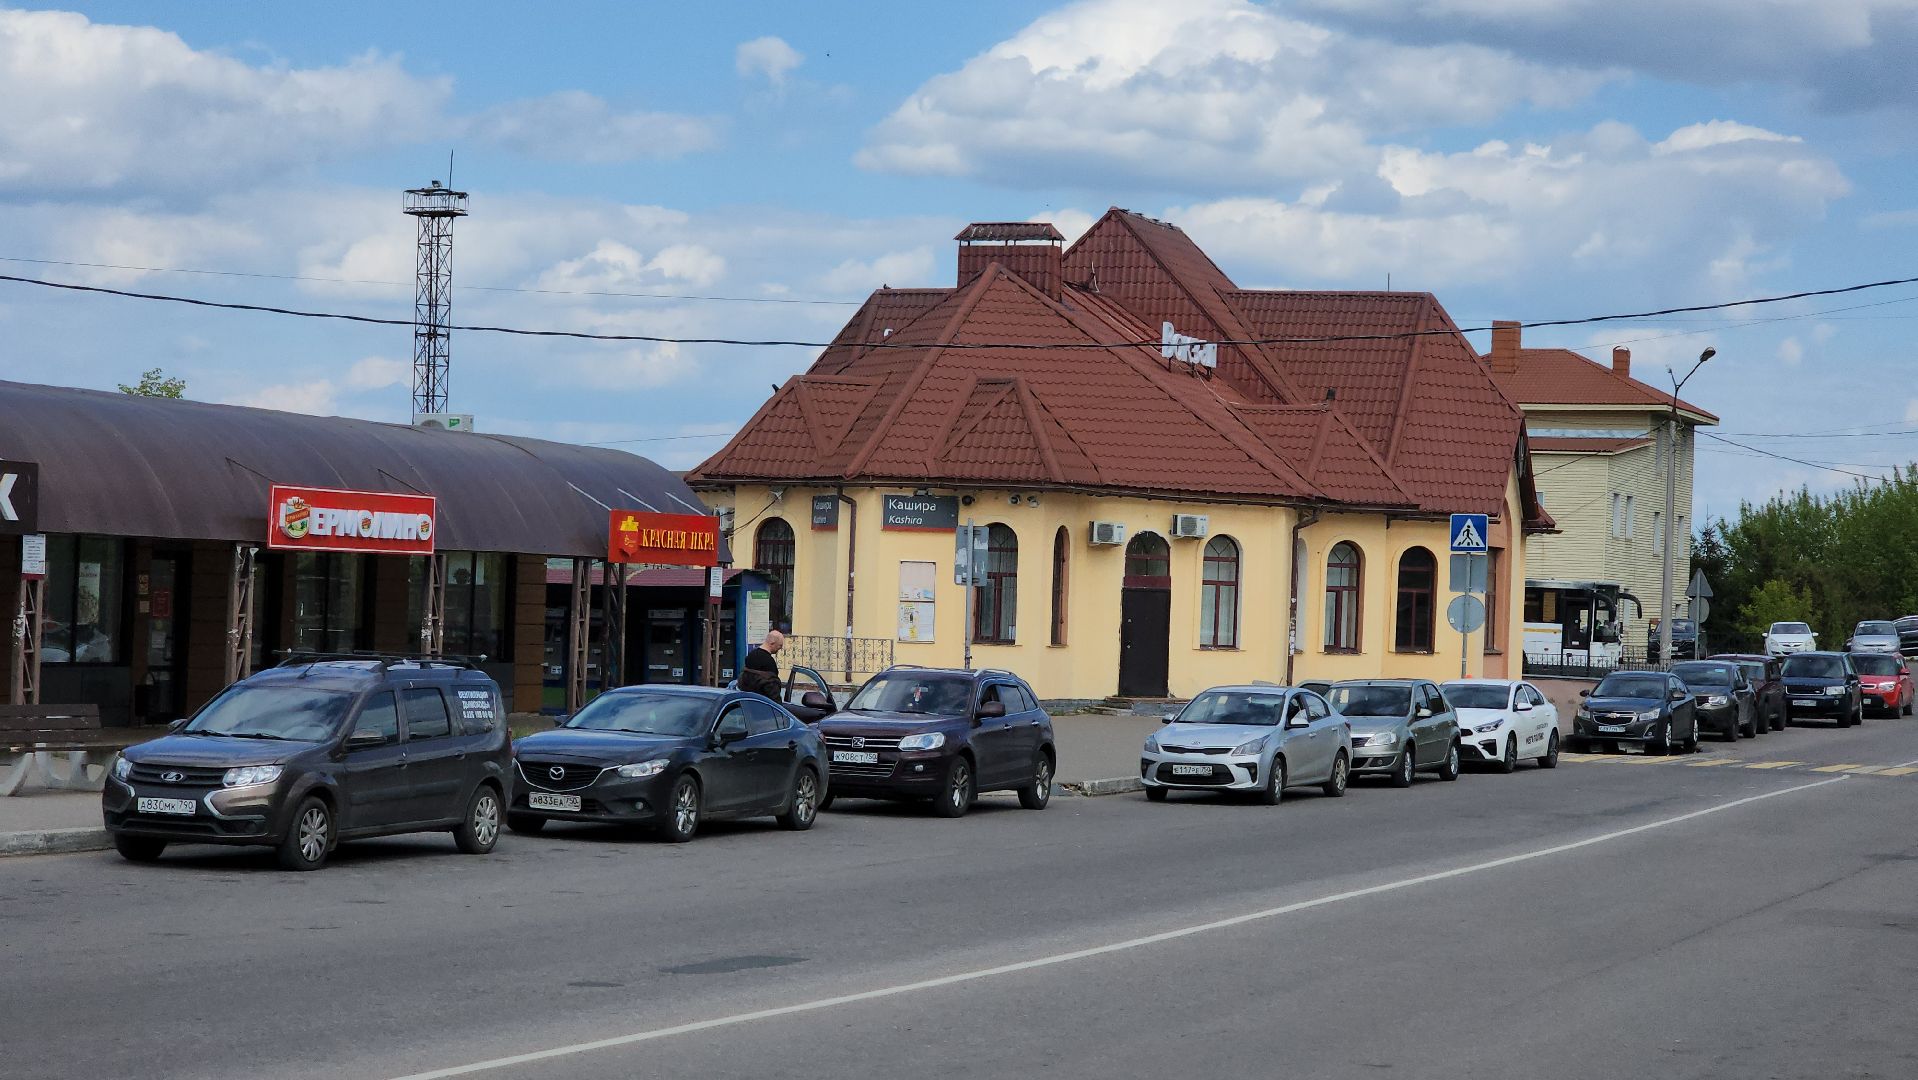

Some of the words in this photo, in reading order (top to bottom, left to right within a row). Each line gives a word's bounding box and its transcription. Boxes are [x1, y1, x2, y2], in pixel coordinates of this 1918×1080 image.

[889, 498, 937, 513] Кашира
[309, 507, 432, 540] ЕРМОЛИНО
[888, 515, 923, 525] Kashira
[642, 528, 686, 549] КРАСНАЯ
